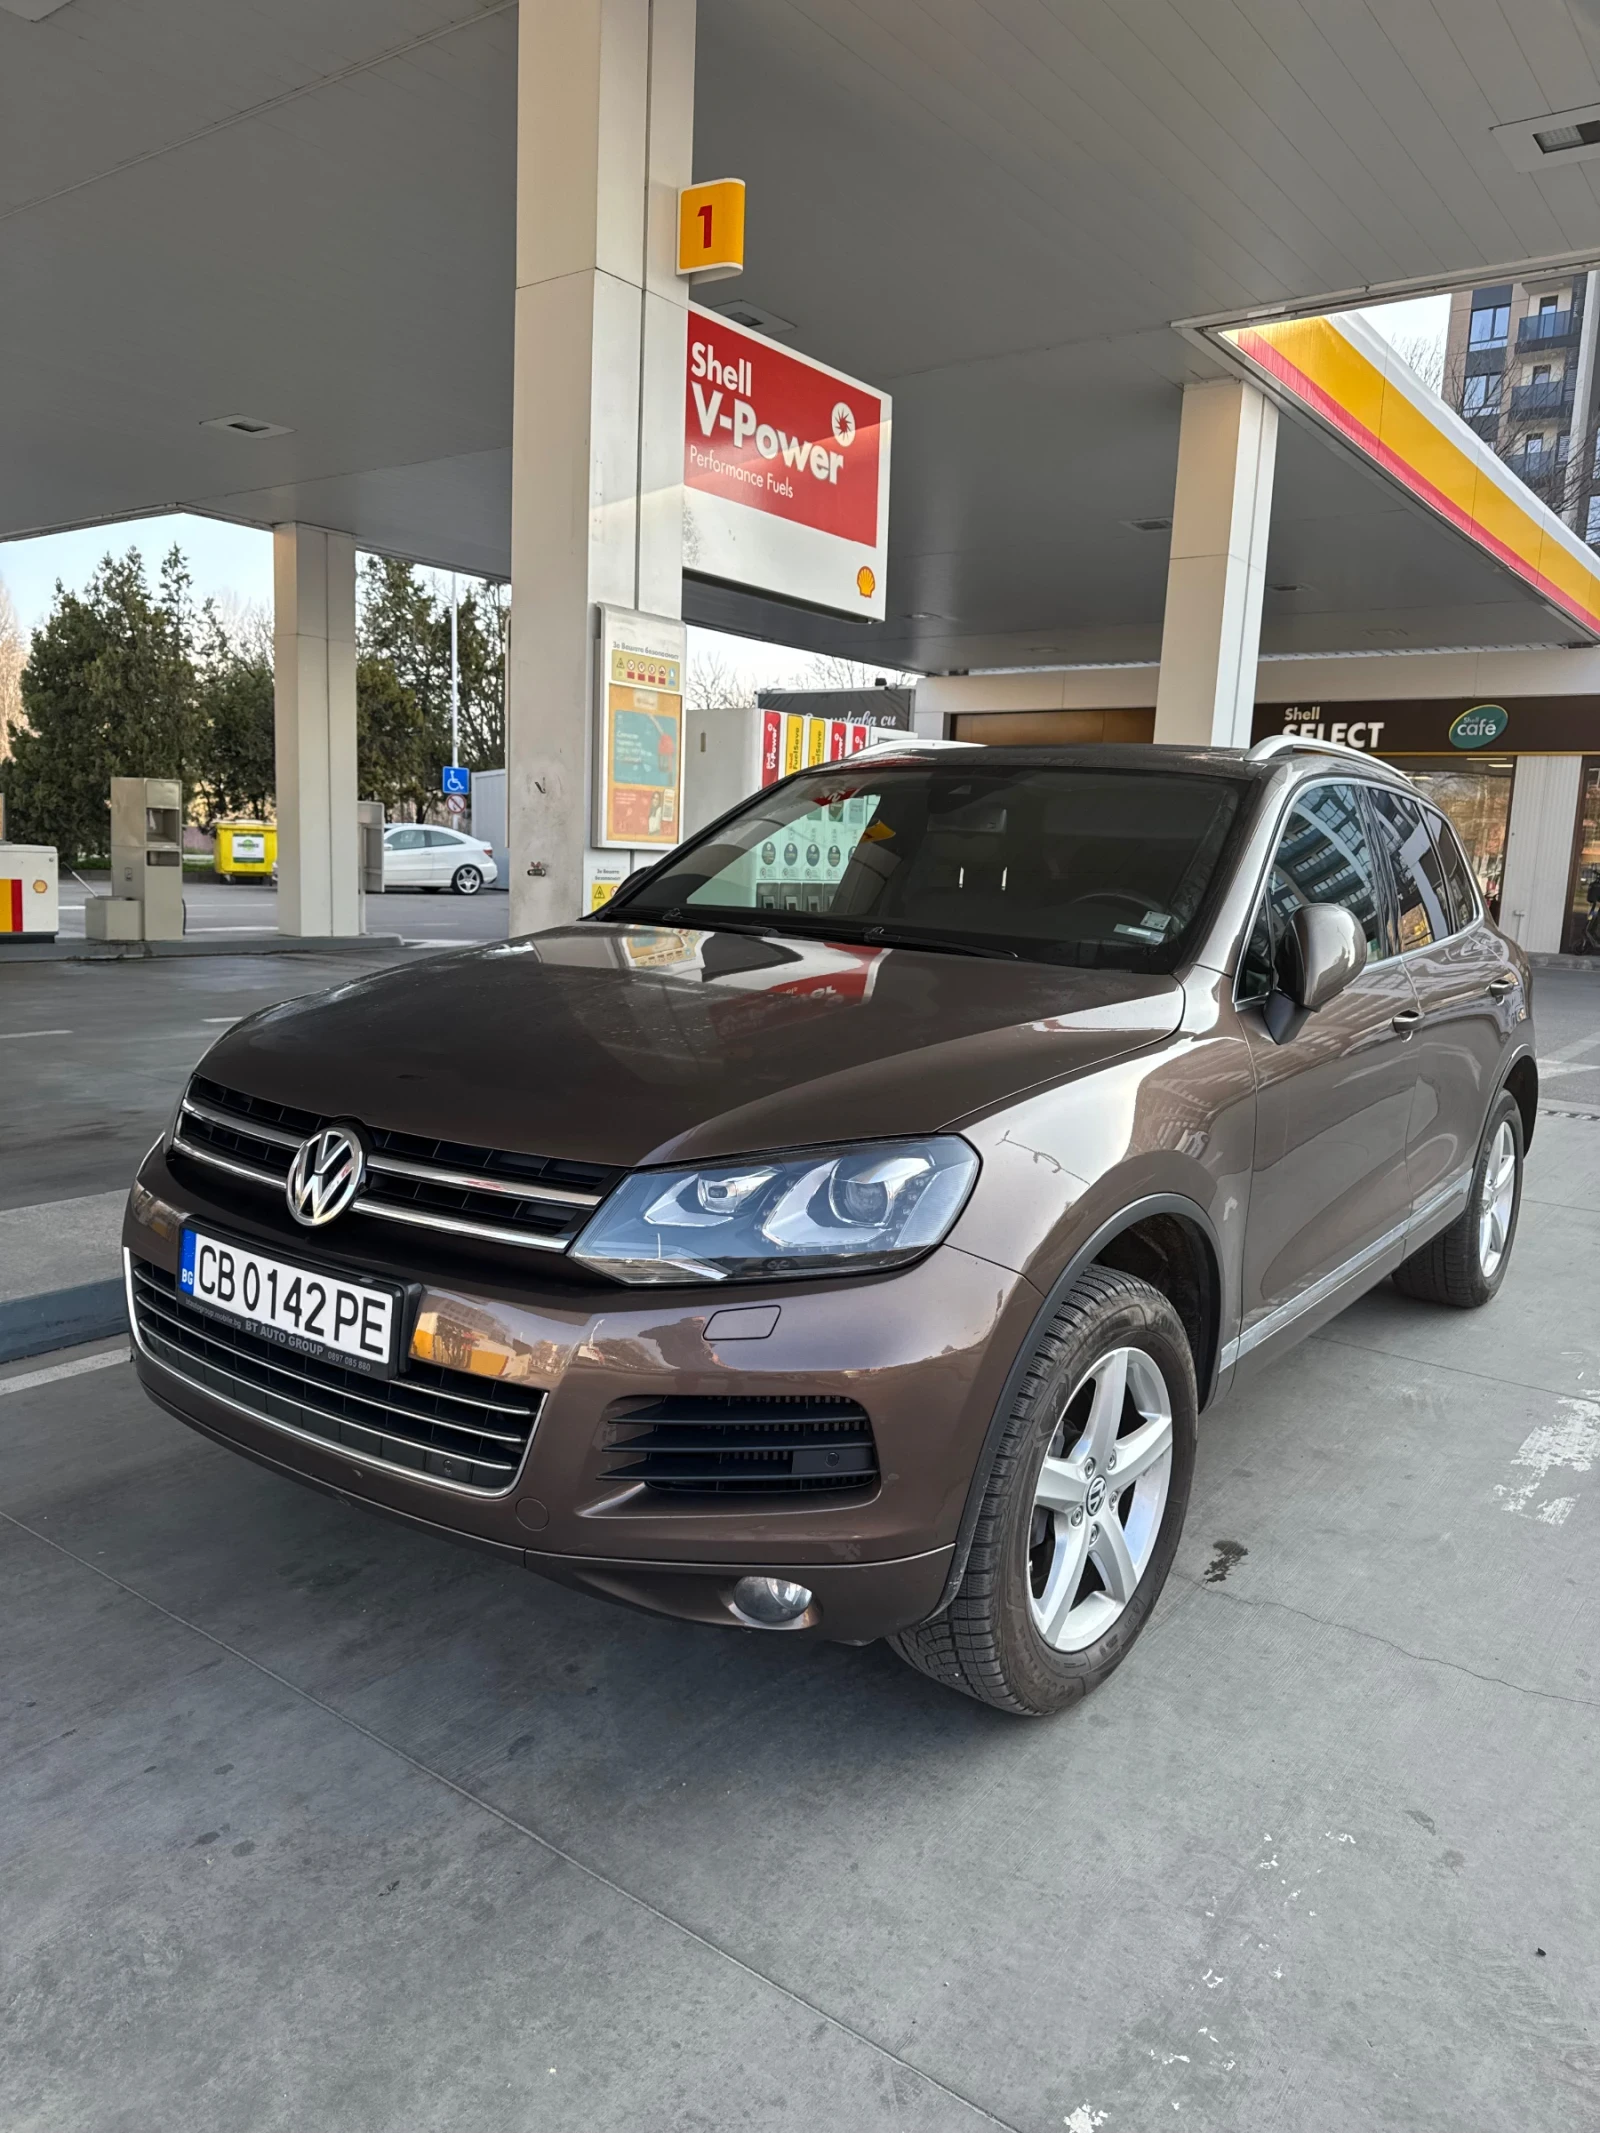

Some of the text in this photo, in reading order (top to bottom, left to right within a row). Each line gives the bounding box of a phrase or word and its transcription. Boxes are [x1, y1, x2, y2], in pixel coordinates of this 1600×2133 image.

[697, 205, 713, 249] 1
[691, 341, 752, 397] Shell
[691, 381, 844, 485] V-Power
[690, 444, 794, 498] Performance Fuels
[1284, 706, 1320, 721] Shell
[1457, 718, 1497, 736] café
[769, 727, 778, 769] V-Power
[182, 1268, 194, 1285] BG
[245, 1319, 258, 1333] BT
[260, 1325, 286, 1344] AUTO
[288, 1335, 324, 1356] GROUP
